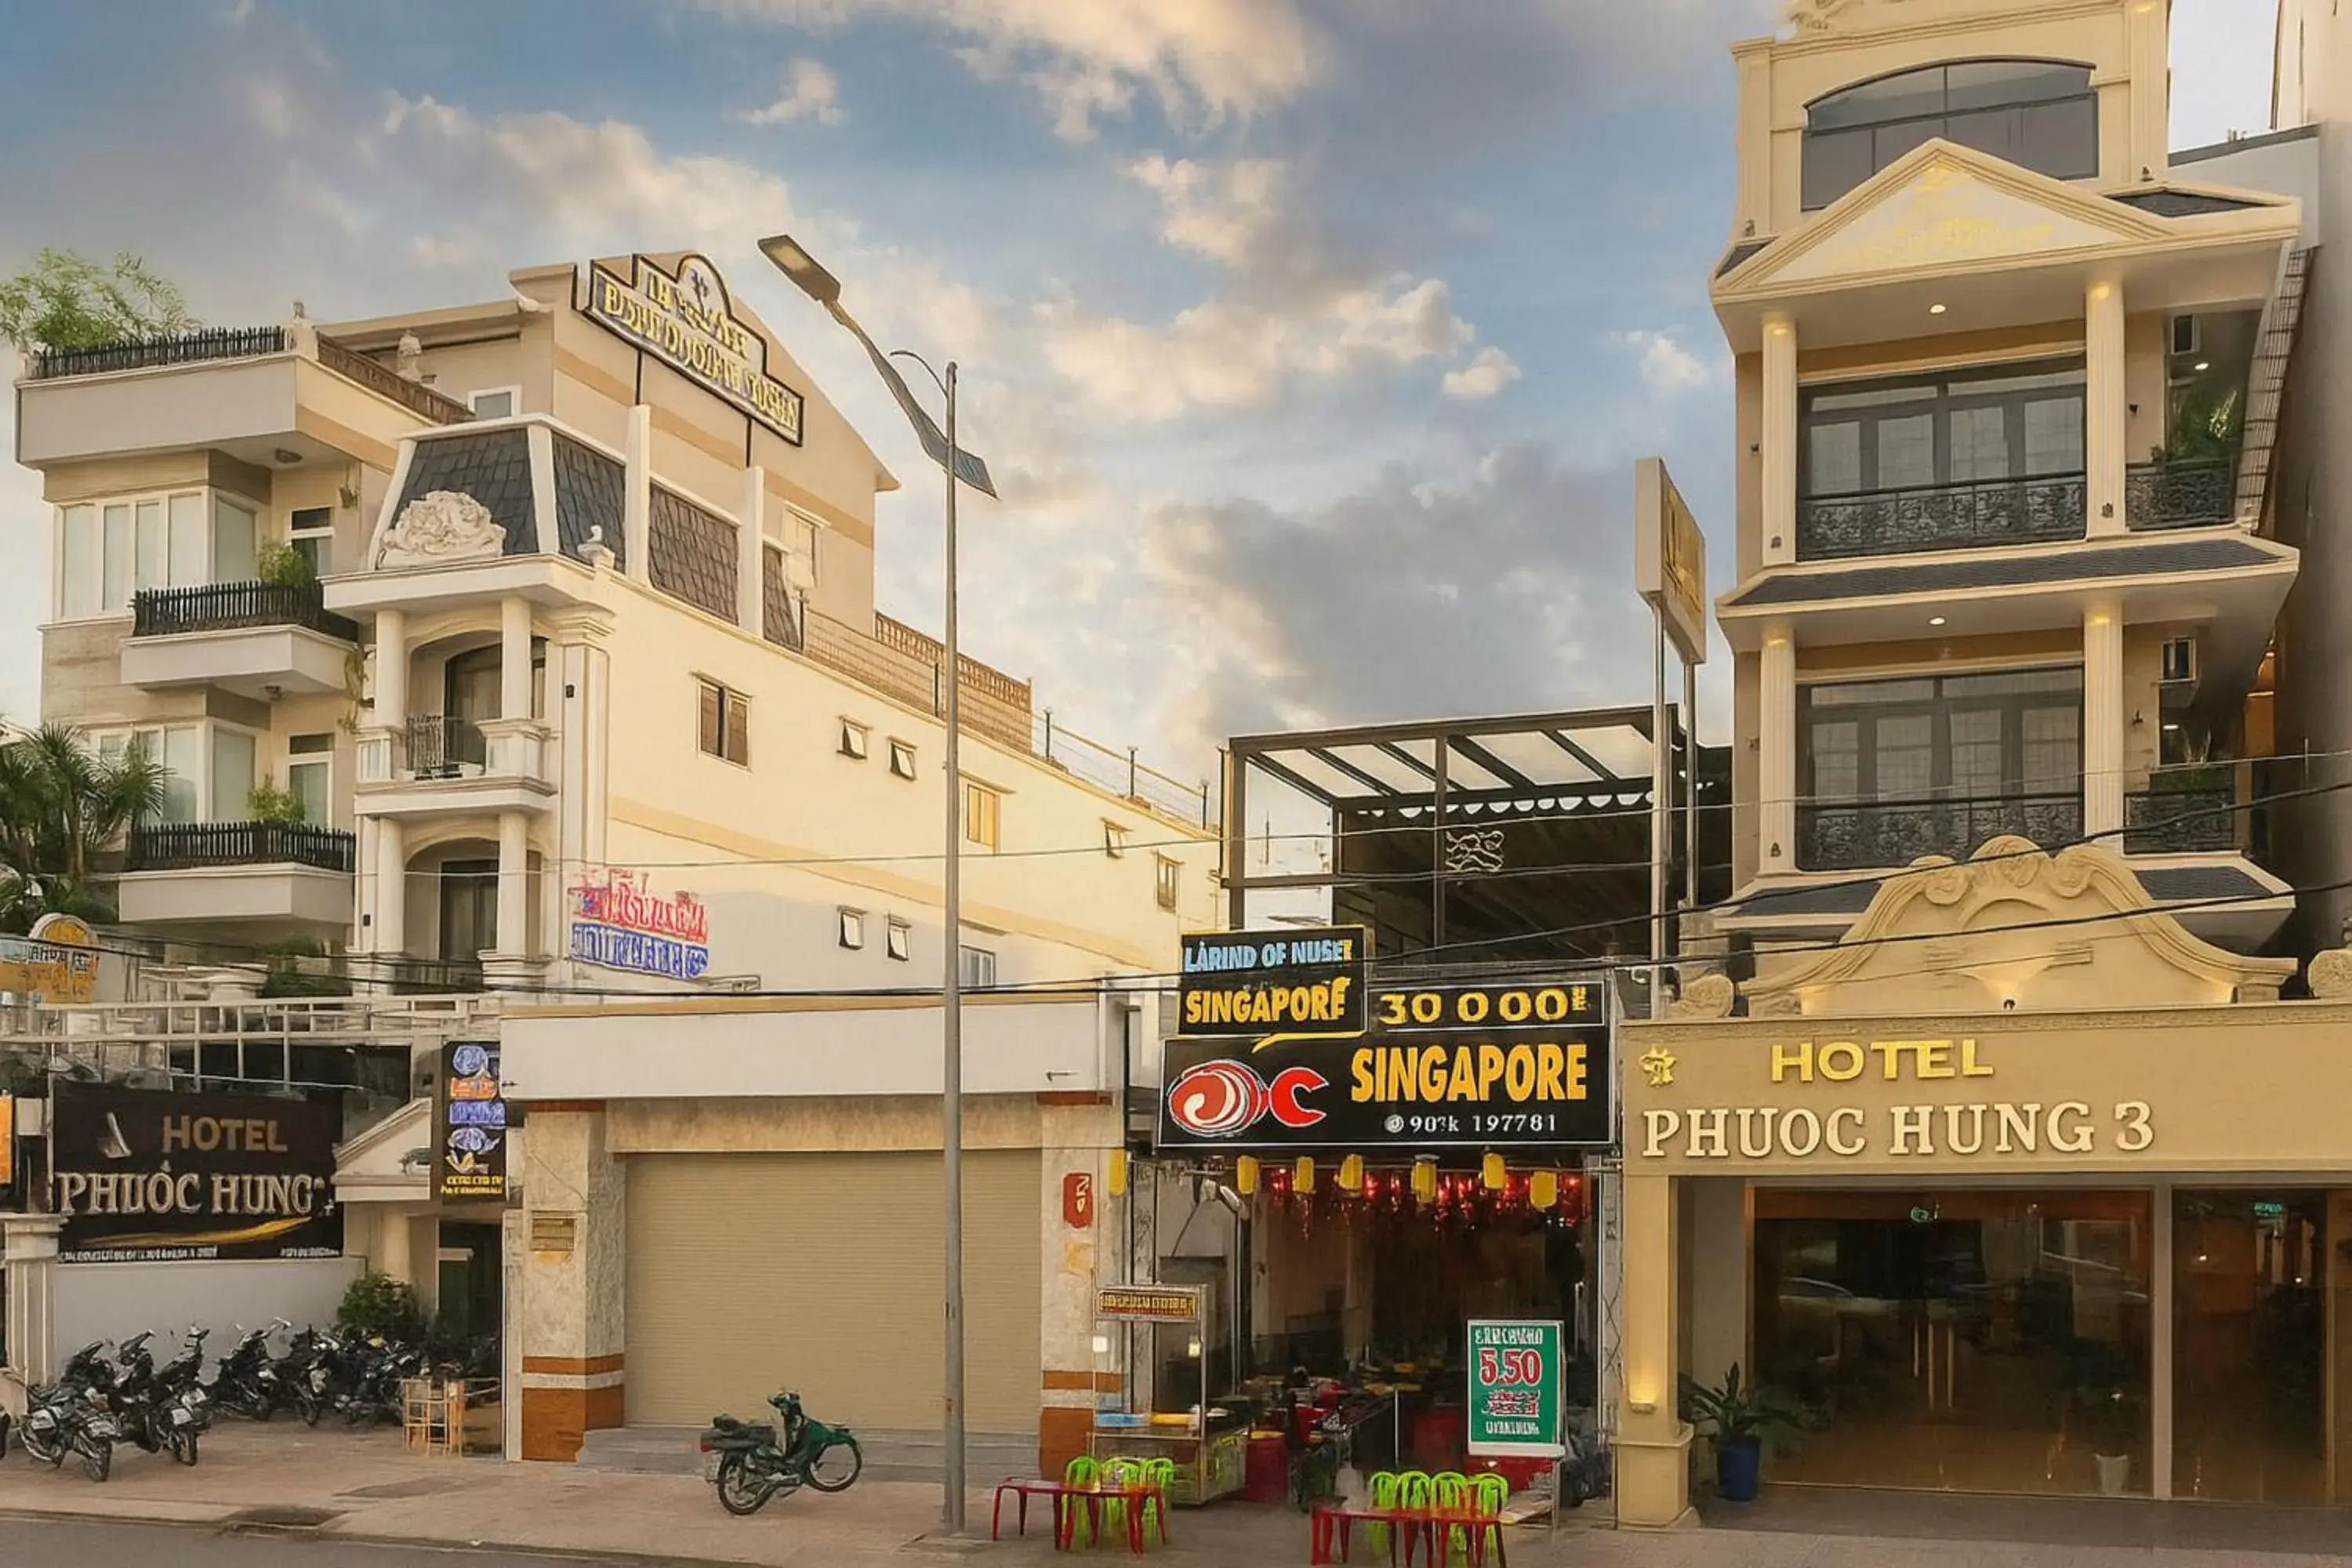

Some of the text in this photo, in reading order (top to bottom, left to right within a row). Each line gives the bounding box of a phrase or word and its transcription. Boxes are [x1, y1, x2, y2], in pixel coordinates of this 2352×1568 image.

[1261, 942, 1287, 967] OF
[1185, 977, 1351, 1024] SINGAPORE
[1350, 1043, 1588, 1102] SINGAPORE
[1771, 1039, 1994, 1082] HOTEL
[161, 1115, 289, 1154] HOTEL
[1471, 1113, 1556, 1133] 197781
[1642, 1101, 2154, 1158] PHUOC HUNG 3
